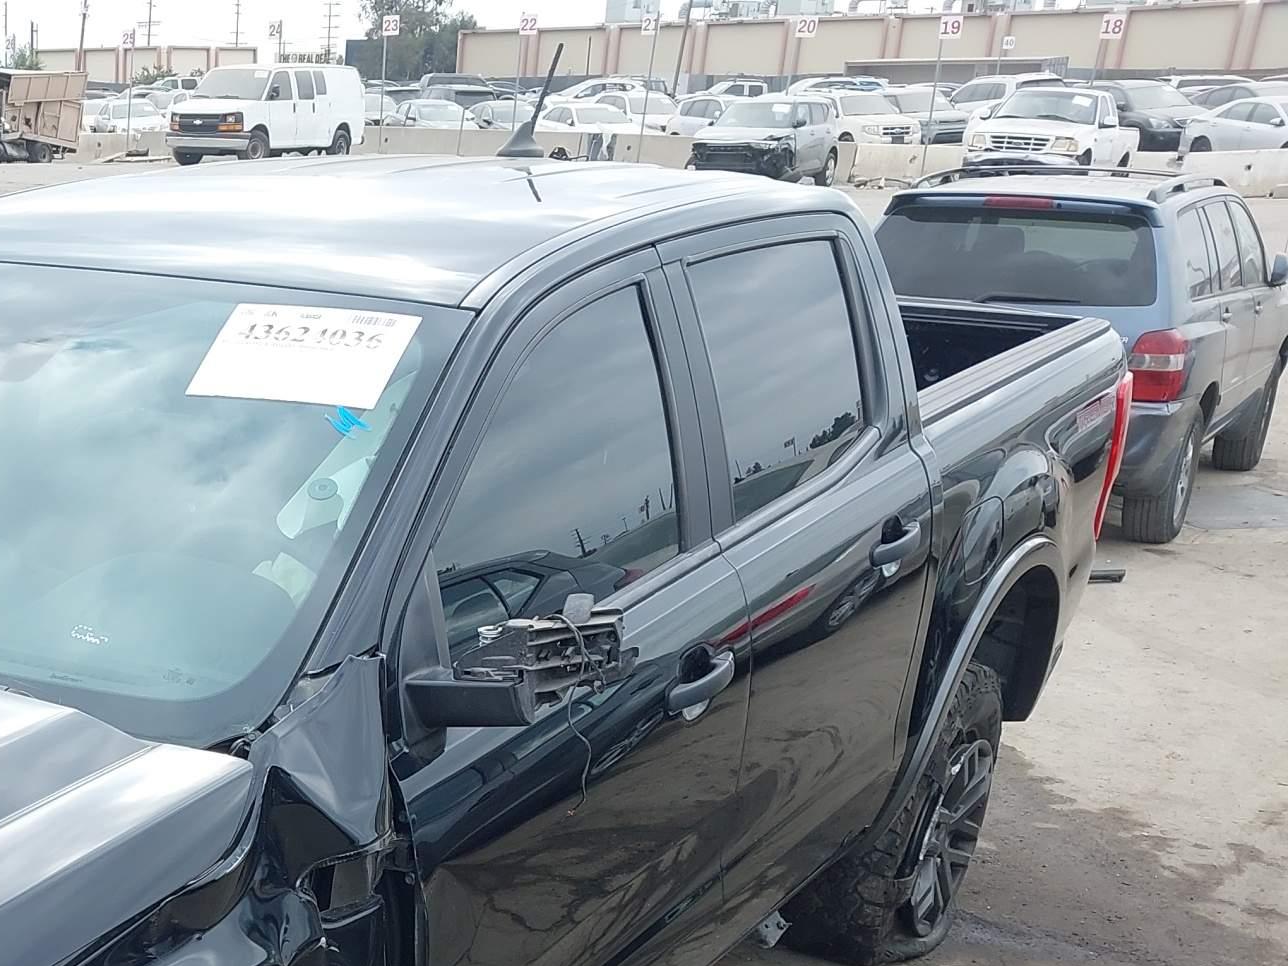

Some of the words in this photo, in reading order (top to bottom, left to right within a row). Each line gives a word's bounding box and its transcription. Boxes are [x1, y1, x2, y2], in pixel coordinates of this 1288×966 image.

[269, 23, 282, 37] 24
[383, 19, 399, 31] 23
[520, 17, 537, 31] 22
[642, 17, 659, 32] 21
[797, 19, 816, 34] 20
[940, 20, 961, 35] 19
[1101, 18, 1124, 34] 18
[122, 32, 134, 45] 25
[298, 53, 314, 64] REAL
